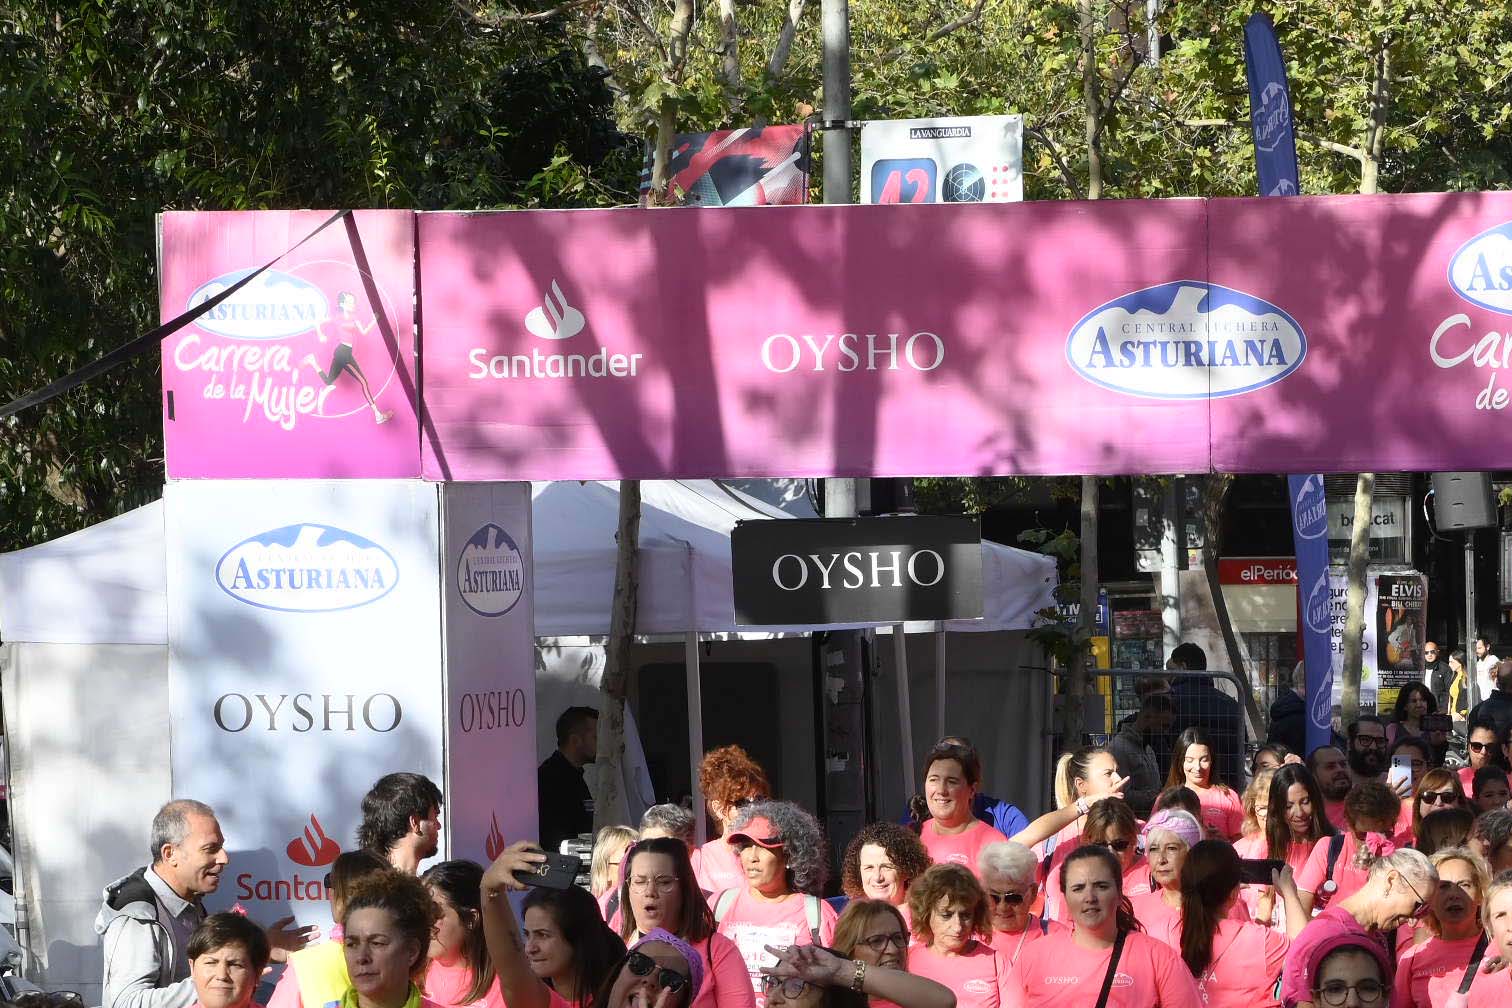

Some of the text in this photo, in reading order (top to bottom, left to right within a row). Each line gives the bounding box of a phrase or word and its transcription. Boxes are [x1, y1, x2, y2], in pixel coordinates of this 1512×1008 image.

[1121, 321, 1196, 335] CENTRAL
[174, 335, 290, 372] Carrera
[469, 348, 643, 379] Santander
[761, 332, 945, 374] OYSHO
[1085, 325, 1289, 369] ASTURIANA
[203, 371, 335, 430] de la Mujer
[1475, 372, 1510, 411] de
[230, 556, 386, 590] ASTURIANA
[463, 559, 521, 593] ASTURIANA
[772, 548, 945, 591] OYSHO
[1391, 584, 1422, 597] ELVIS
[213, 692, 402, 734] OYSHO
[460, 688, 526, 732] OYSHO
[237, 873, 331, 901] Santa
[1044, 976, 1080, 985] OYSHO
